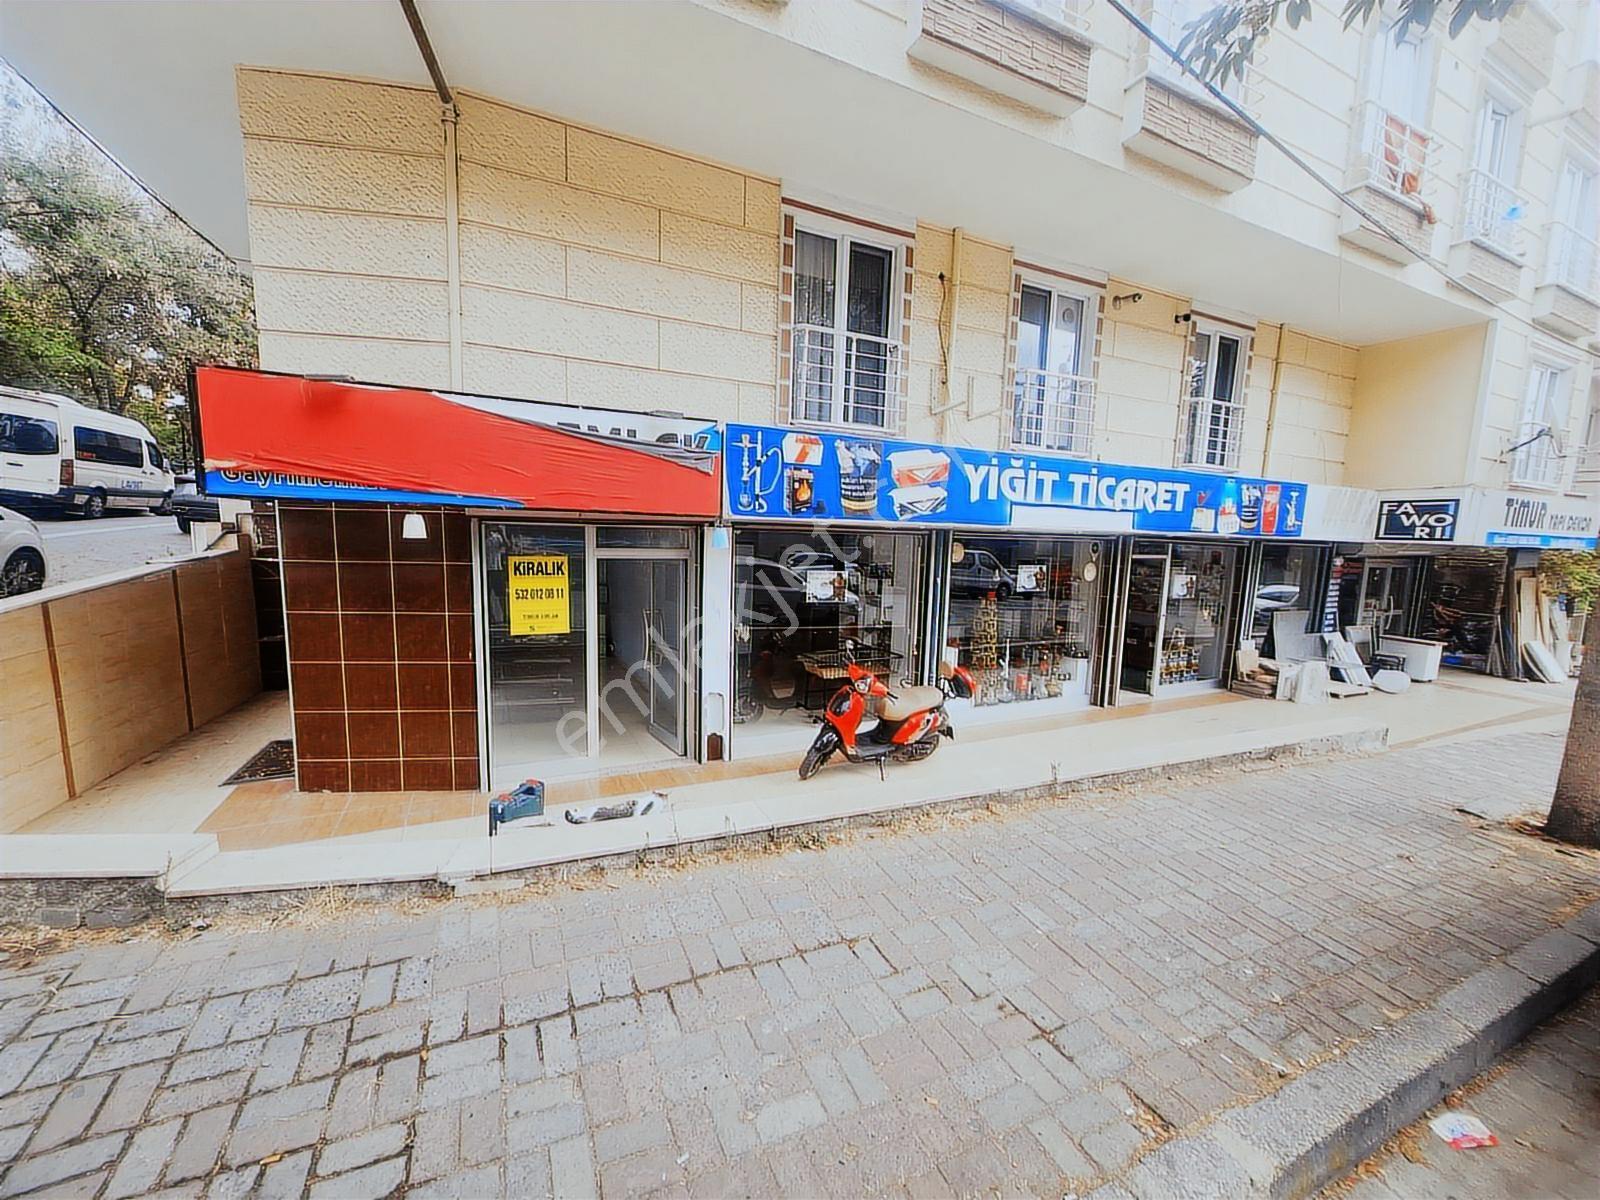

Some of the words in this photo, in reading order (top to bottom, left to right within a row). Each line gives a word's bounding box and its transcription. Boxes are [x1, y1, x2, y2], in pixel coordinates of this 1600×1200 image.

[964, 457, 1060, 503] YİĞİT
[1068, 466, 1190, 513] TİCARET
[515, 588, 529, 600] 532
[530, 588, 544, 600] 012
[556, 587, 564, 599] 11
